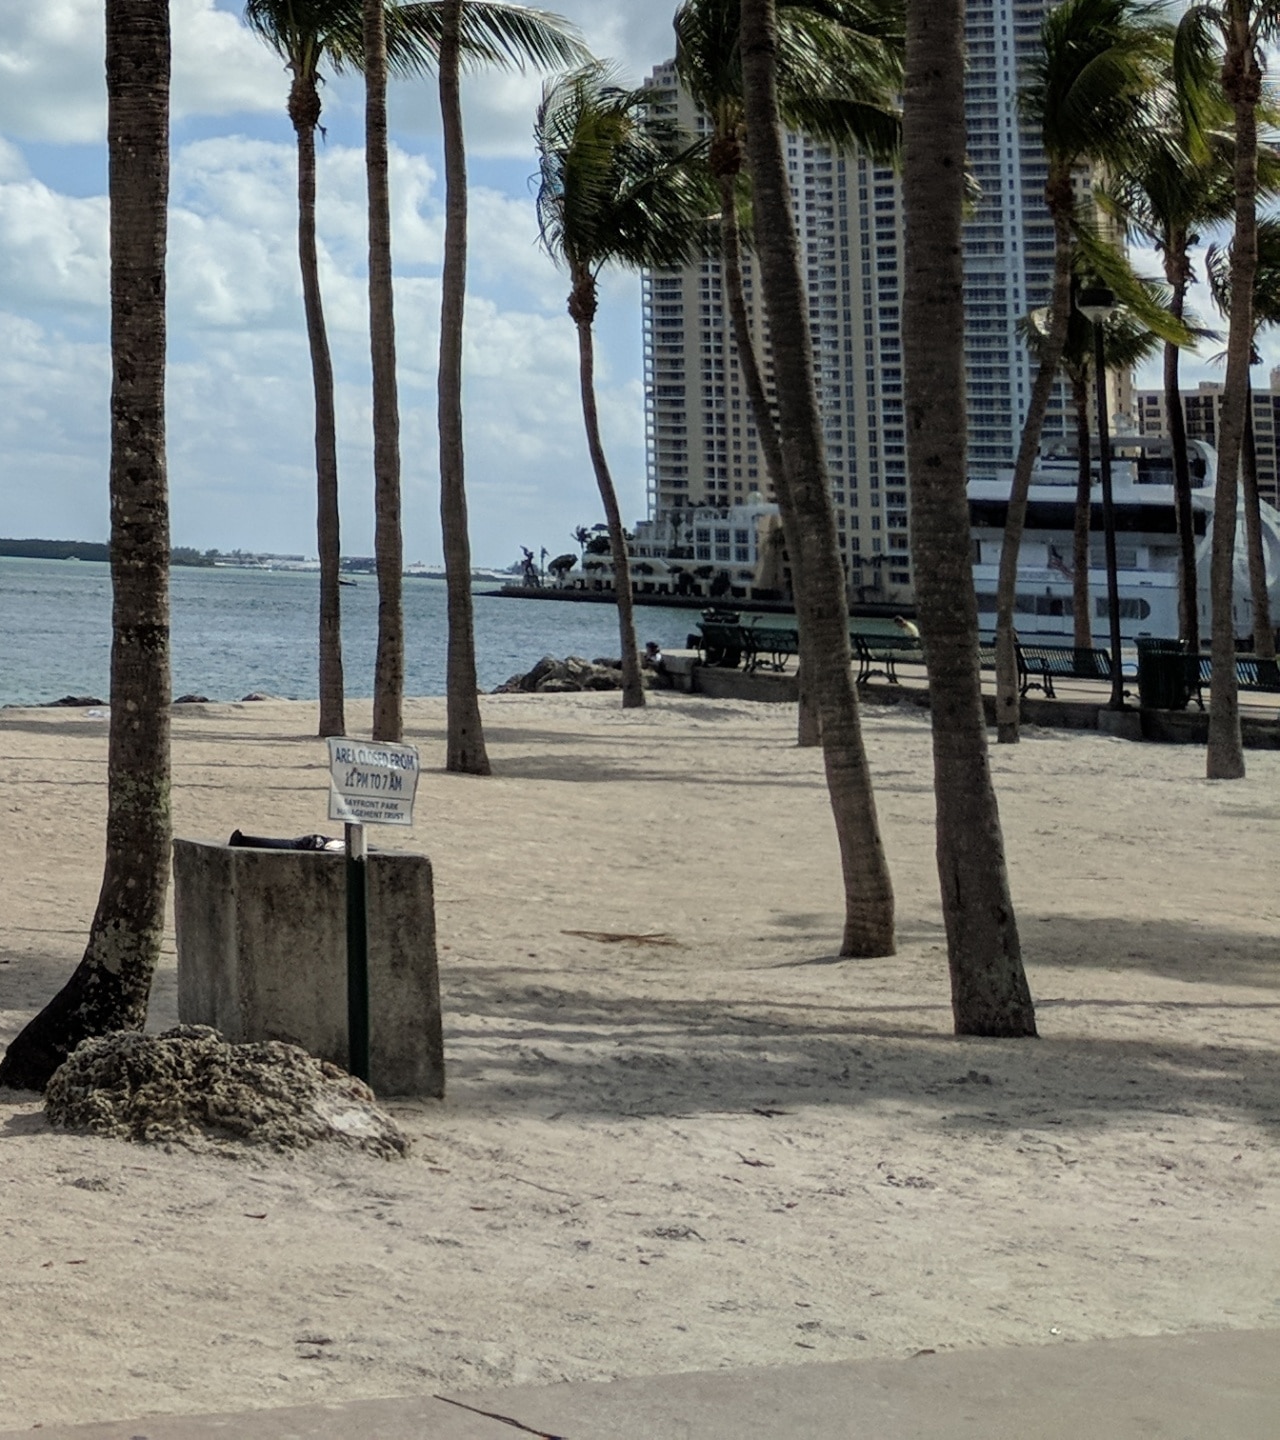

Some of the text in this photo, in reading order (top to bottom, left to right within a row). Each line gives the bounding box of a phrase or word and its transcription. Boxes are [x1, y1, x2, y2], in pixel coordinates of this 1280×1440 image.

[335, 747, 415, 771] AREA CLOSED FROM
[356, 772, 368, 788] PM
[370, 773, 381, 789] TO
[382, 774, 388, 789] 7
[389, 775, 402, 791] AM
[380, 801, 399, 810] PARK
[384, 811, 404, 819] TRUST
